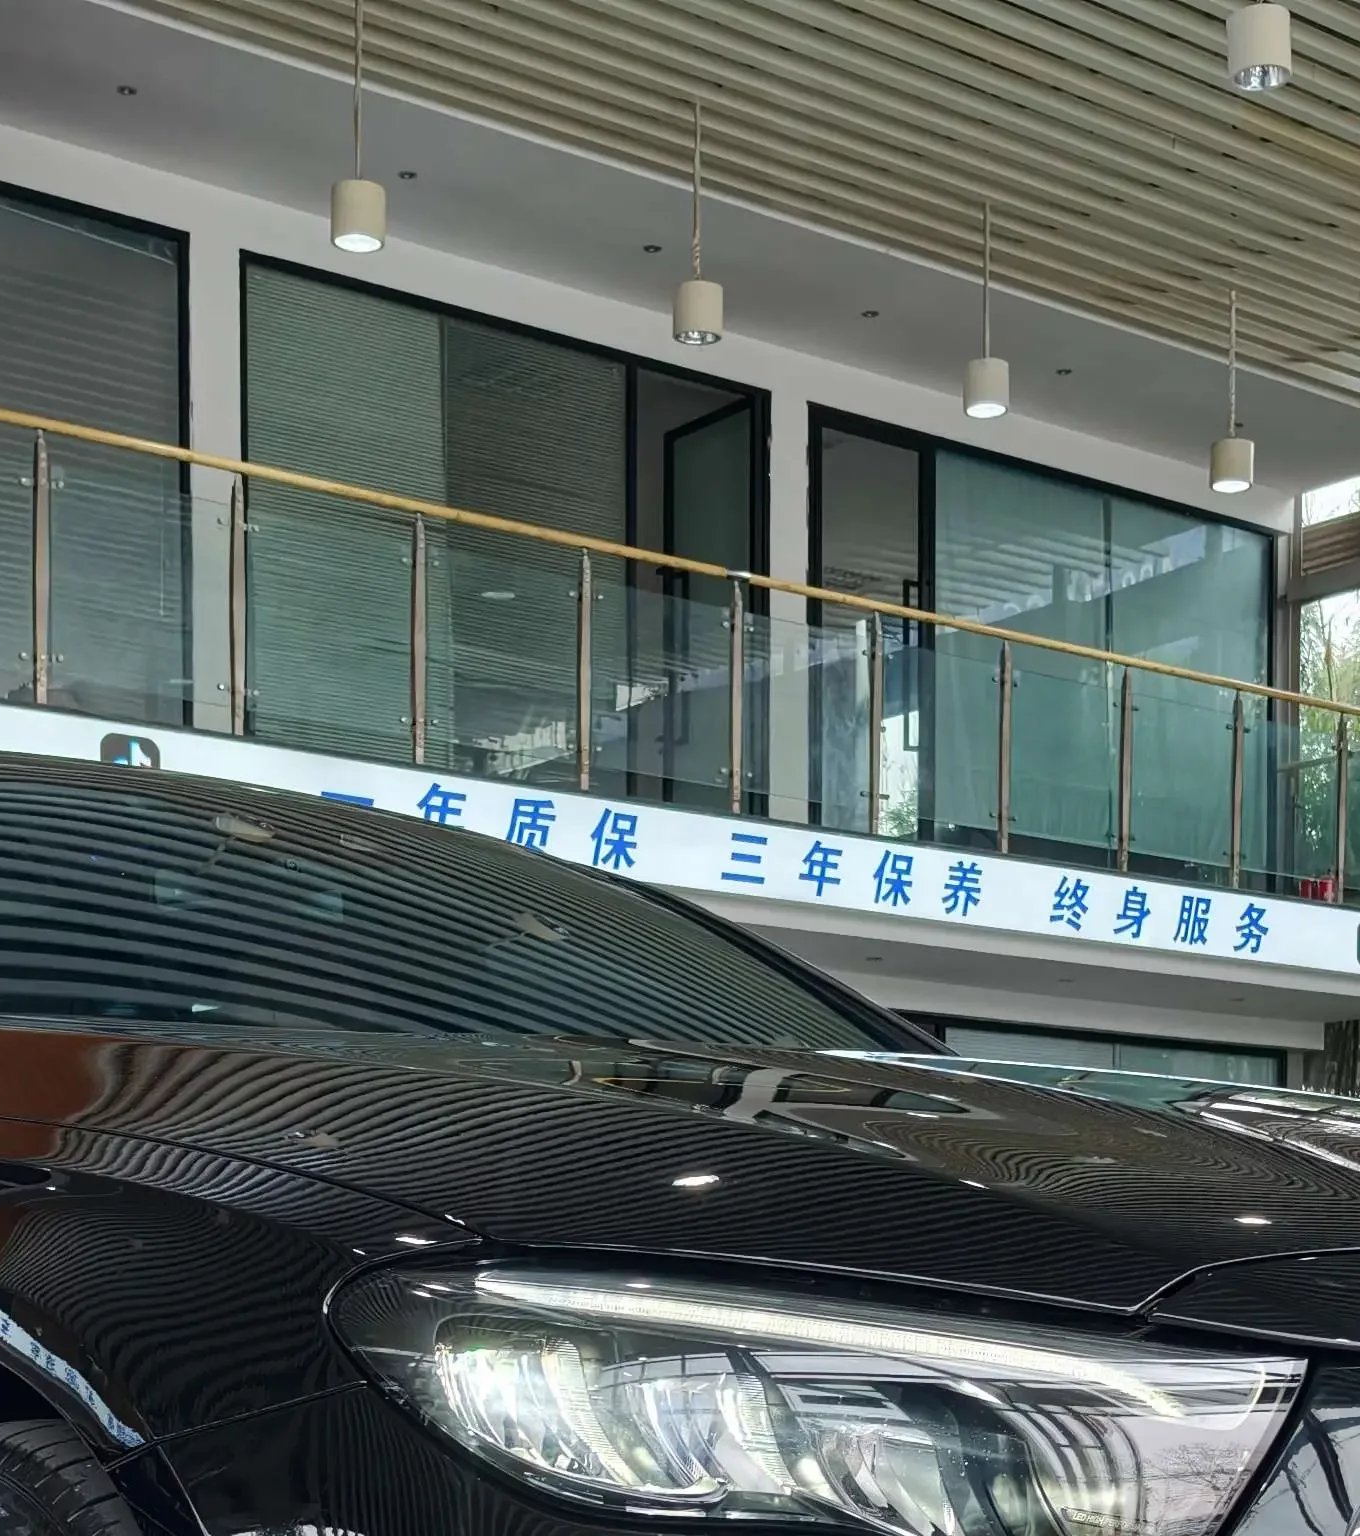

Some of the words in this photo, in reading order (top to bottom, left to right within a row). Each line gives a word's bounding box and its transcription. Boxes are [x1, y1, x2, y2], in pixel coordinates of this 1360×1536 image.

[721, 832, 983, 917] 三年保养
[1049, 874, 1270, 955] 终身服务
